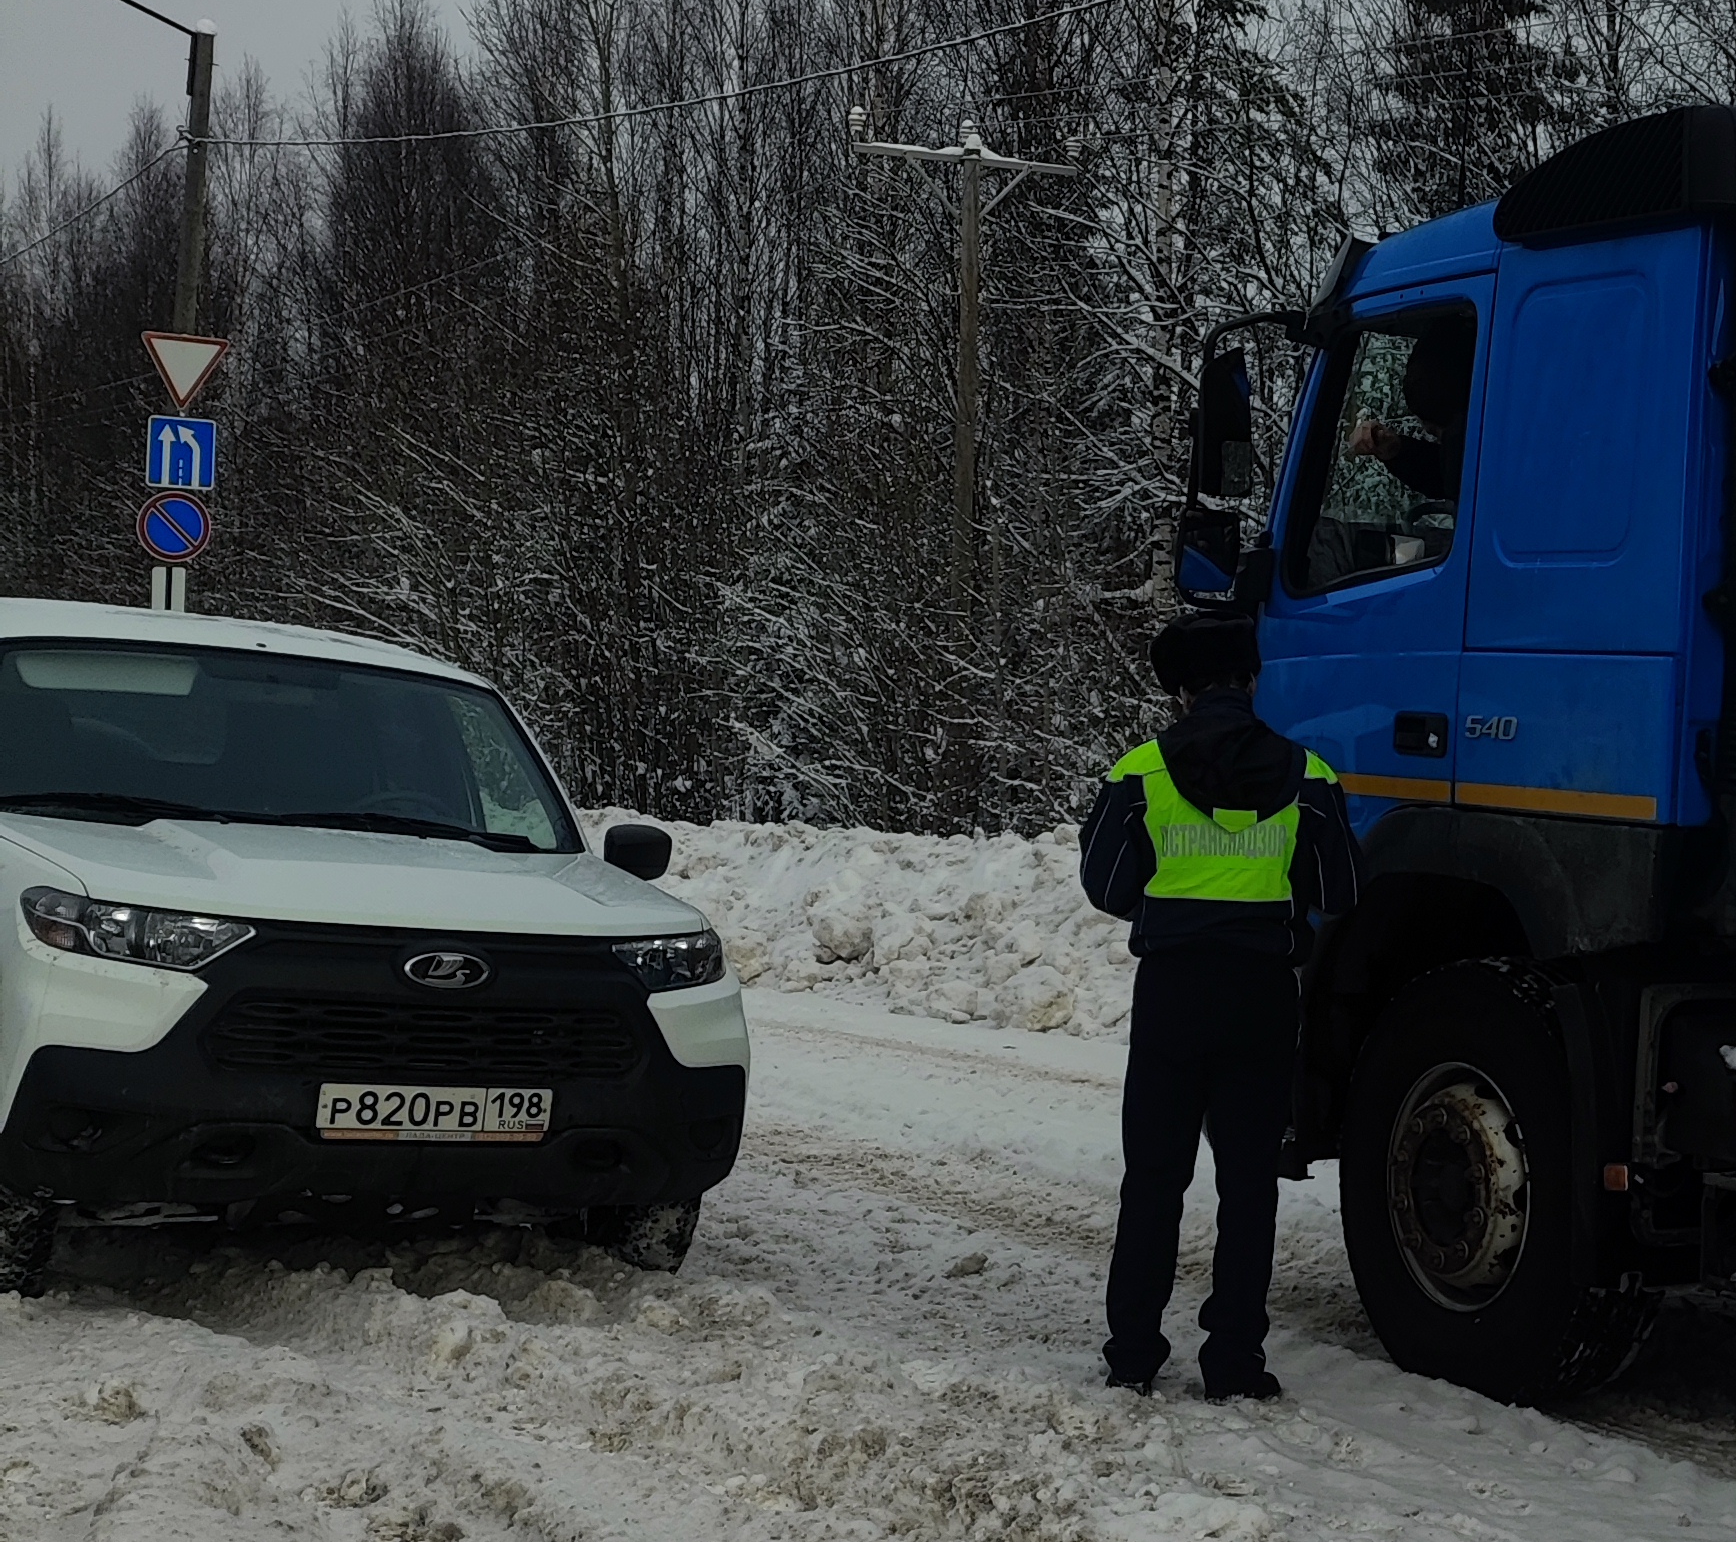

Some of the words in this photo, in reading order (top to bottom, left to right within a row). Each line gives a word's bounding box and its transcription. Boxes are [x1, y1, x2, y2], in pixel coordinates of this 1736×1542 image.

[1465, 715, 1517, 739] 540
[1160, 825, 1287, 858] ОСТРАНСНАДЗОР
[329, 1091, 479, 1126] Р820РВ
[491, 1092, 542, 1119] 198
[498, 1120, 524, 1130] RUS
